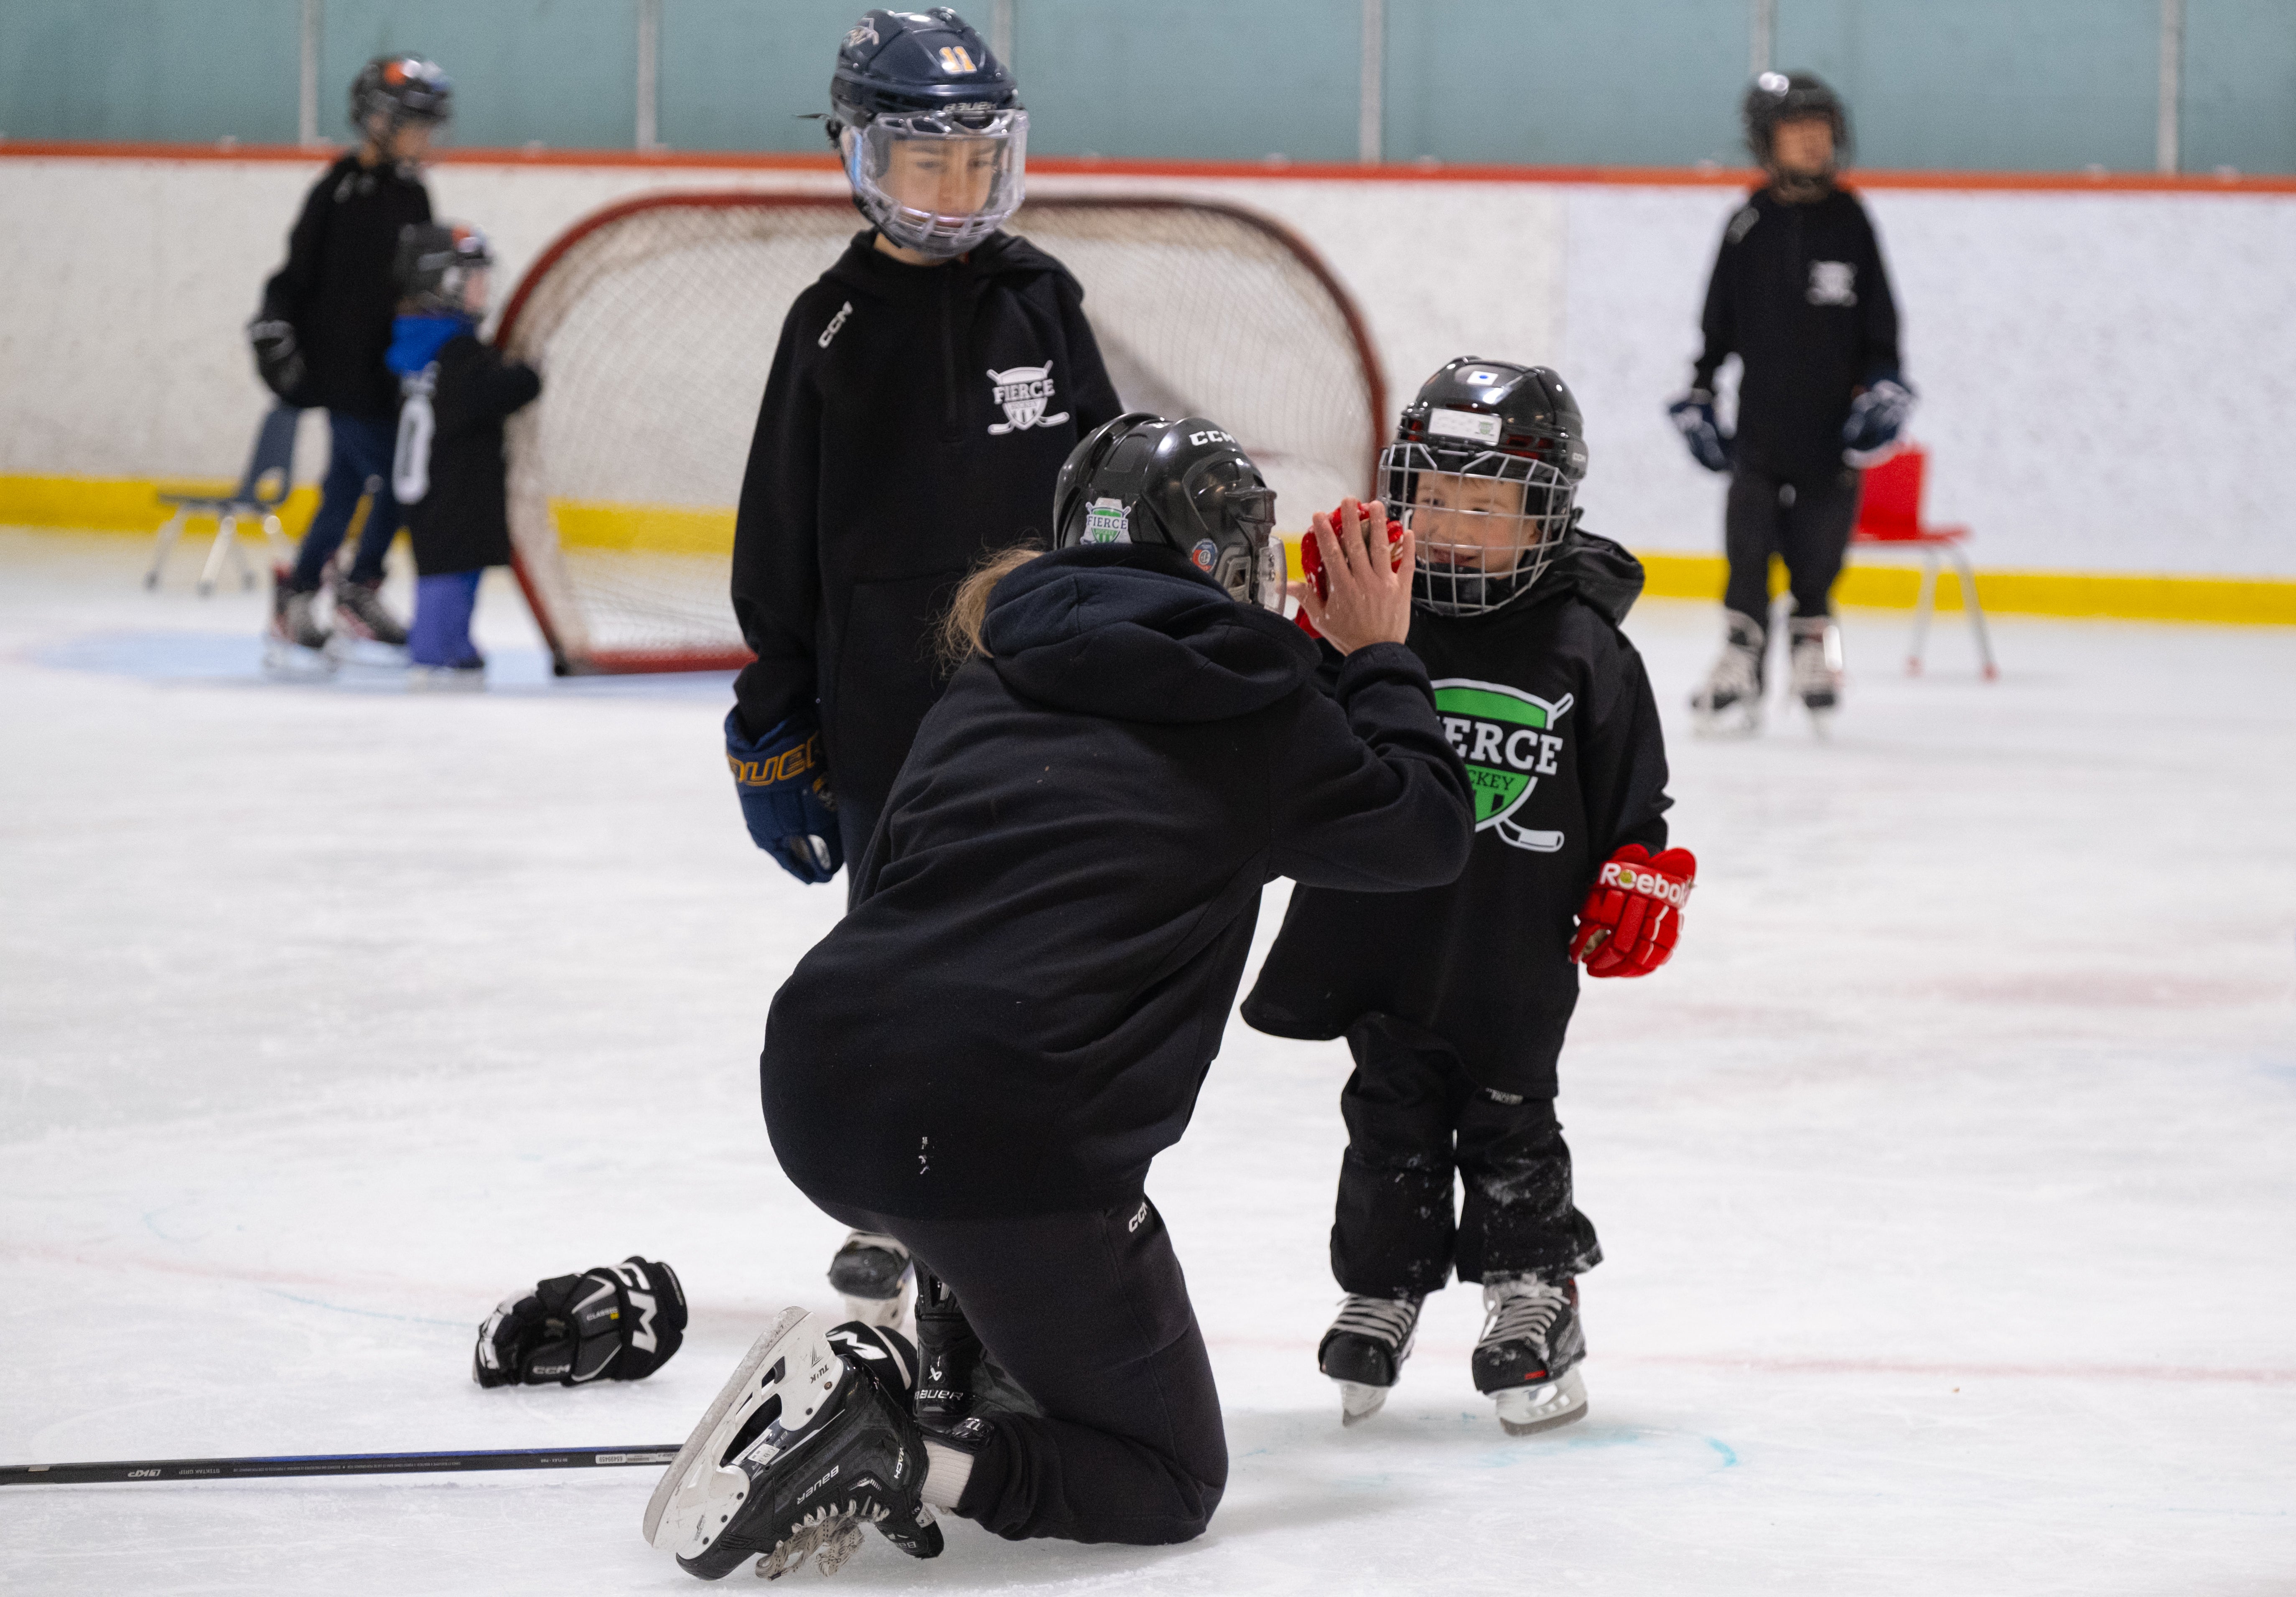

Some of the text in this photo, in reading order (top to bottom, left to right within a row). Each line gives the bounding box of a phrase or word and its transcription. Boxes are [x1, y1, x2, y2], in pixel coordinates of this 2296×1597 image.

[939, 46, 977, 75] 11
[993, 379, 1056, 404] FIERCE
[1189, 430, 1236, 446] CCM
[1087, 516, 1127, 529] FIERCE
[1437, 716, 1563, 776] ERCE
[1467, 769, 1515, 791] CKEY
[533, 1364, 571, 1375] CCM
[893, 1444, 904, 1479] MACH
[797, 1465, 839, 1505] BAUER
